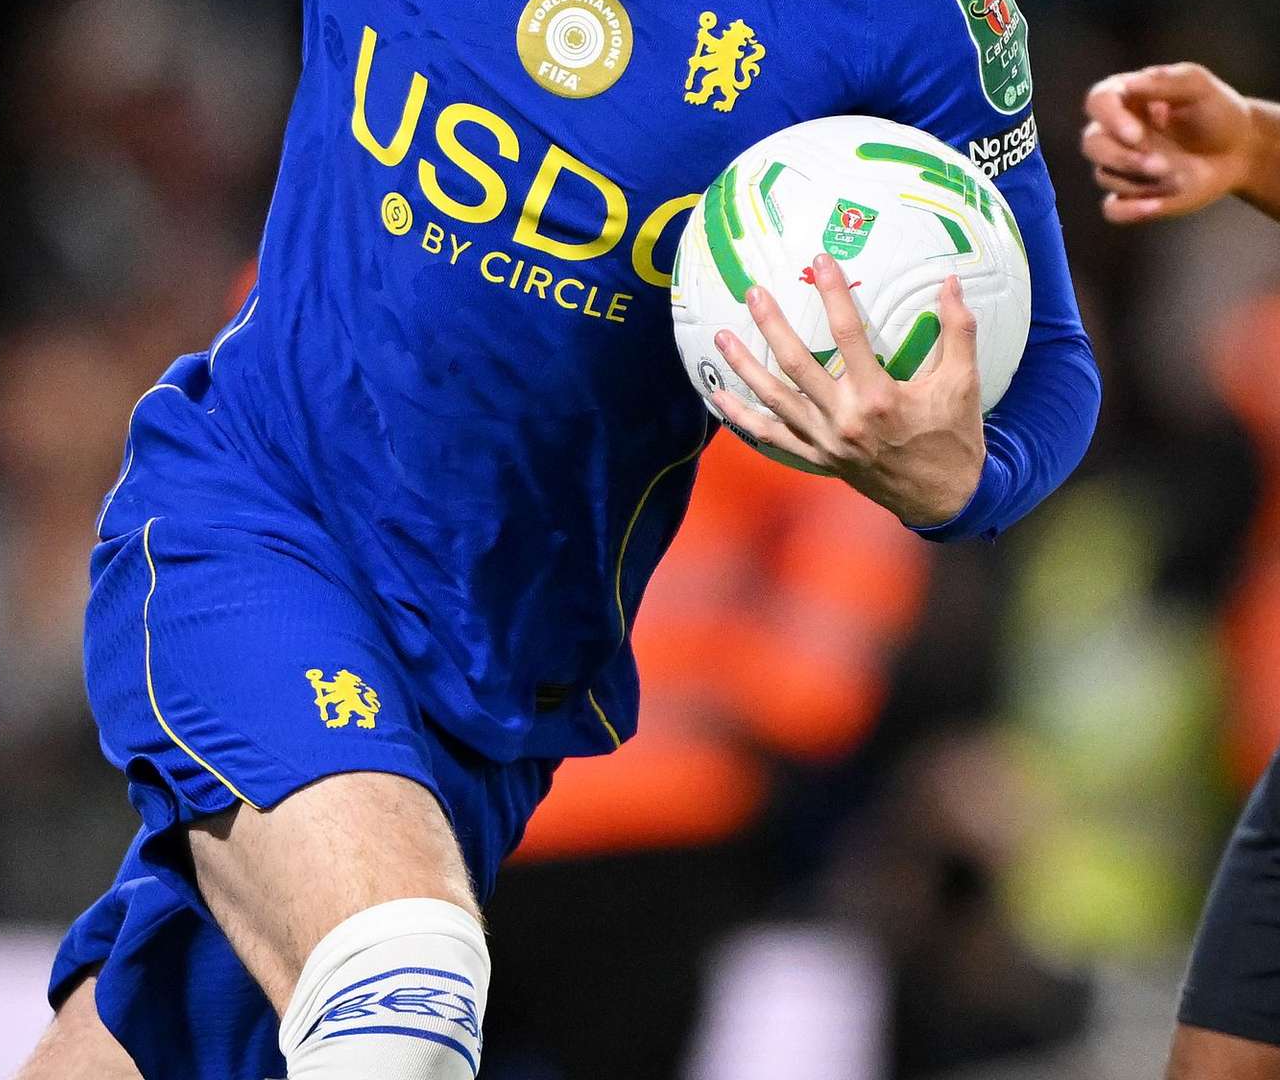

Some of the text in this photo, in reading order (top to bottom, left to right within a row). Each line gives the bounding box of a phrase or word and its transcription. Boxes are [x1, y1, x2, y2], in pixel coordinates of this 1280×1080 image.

[985, 11, 1020, 65] Carabao
[1000, 40, 1019, 69] Cup
[538, 60, 578, 91] FIFA
[968, 136, 1001, 162] No
[420, 221, 634, 323] BY CIRCLE
